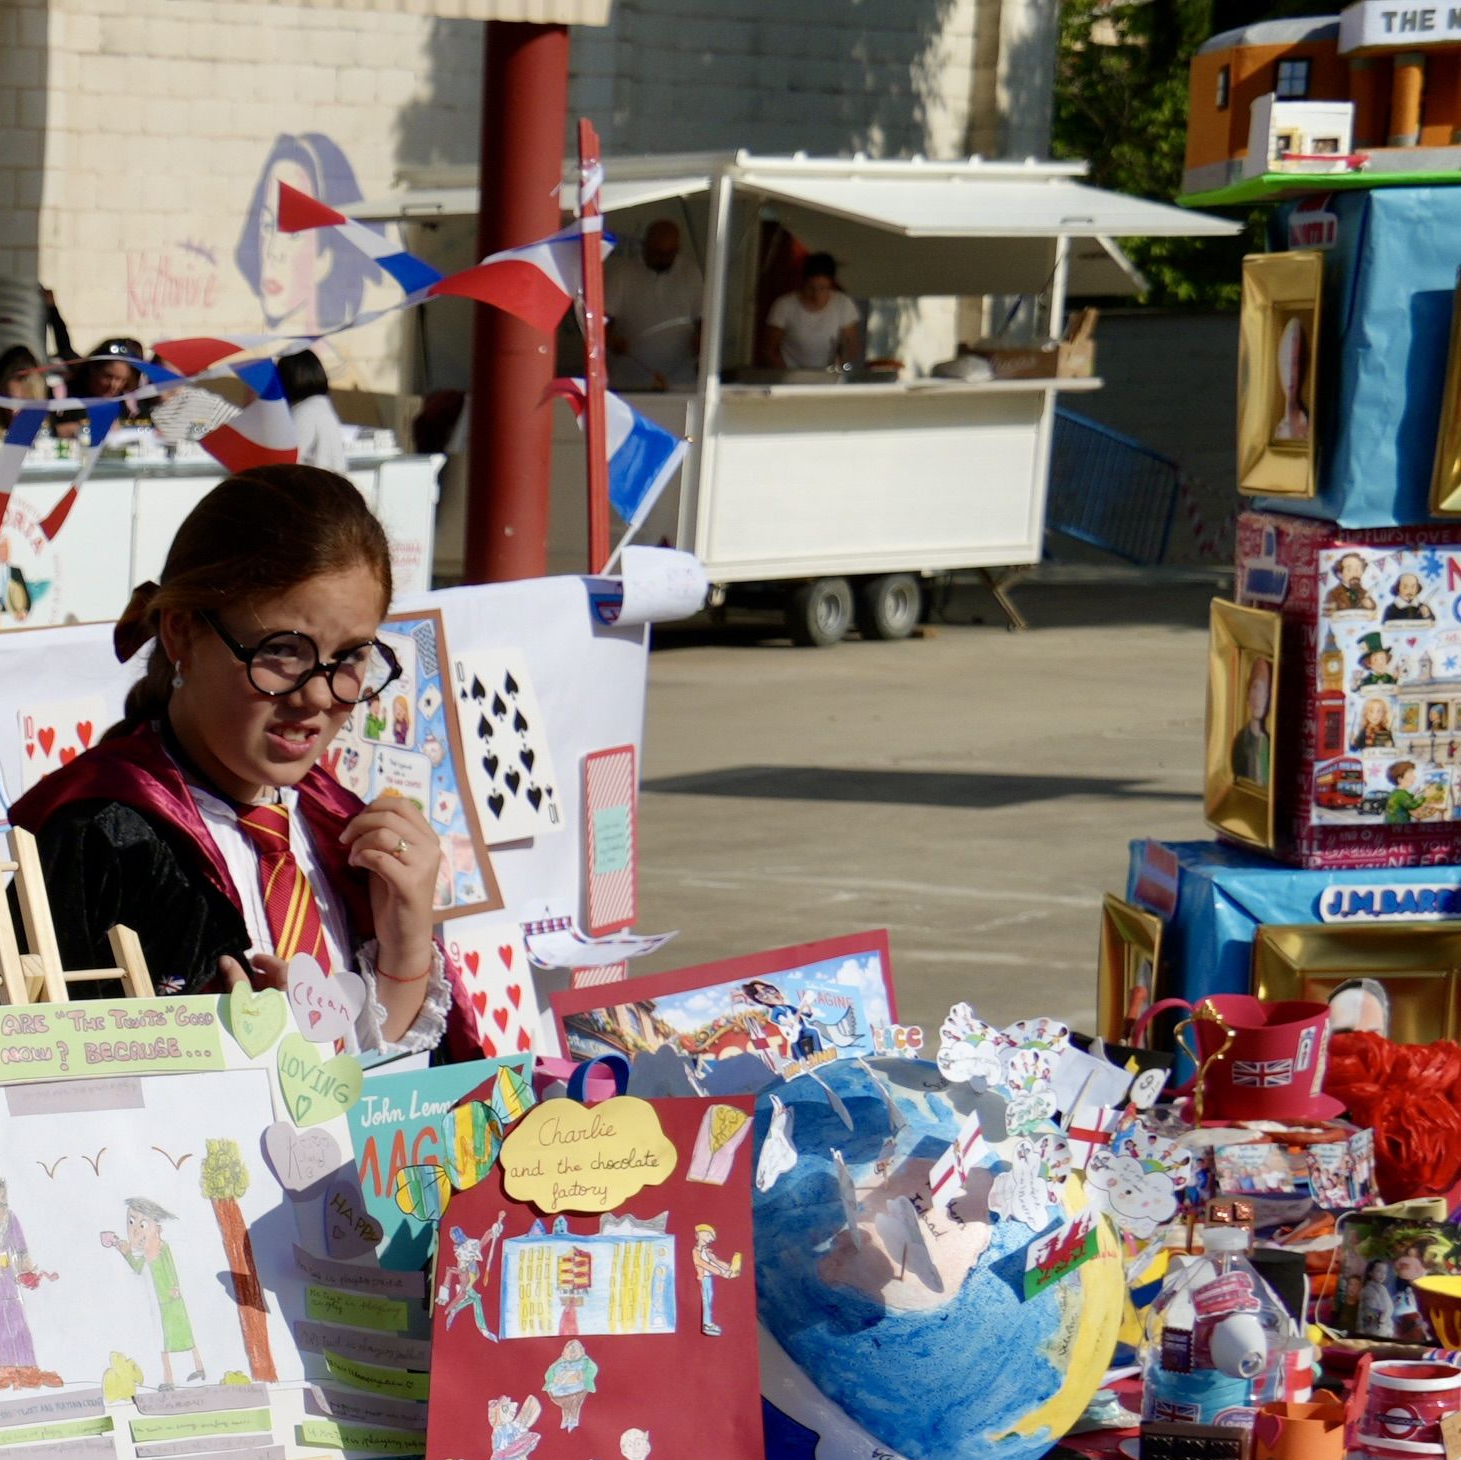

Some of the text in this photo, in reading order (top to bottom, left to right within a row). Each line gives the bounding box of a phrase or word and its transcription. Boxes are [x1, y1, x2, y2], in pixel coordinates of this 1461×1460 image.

[1382, 9, 1437, 33] THE
[0, 1012, 50, 1037] ARE
[279, 1051, 350, 1104] LOVING
[361, 1090, 456, 1128] John Lenn
[538, 1115, 618, 1147] Charlie
[510, 1149, 660, 1179] and the chocolate
[550, 1178, 609, 1206] factory
